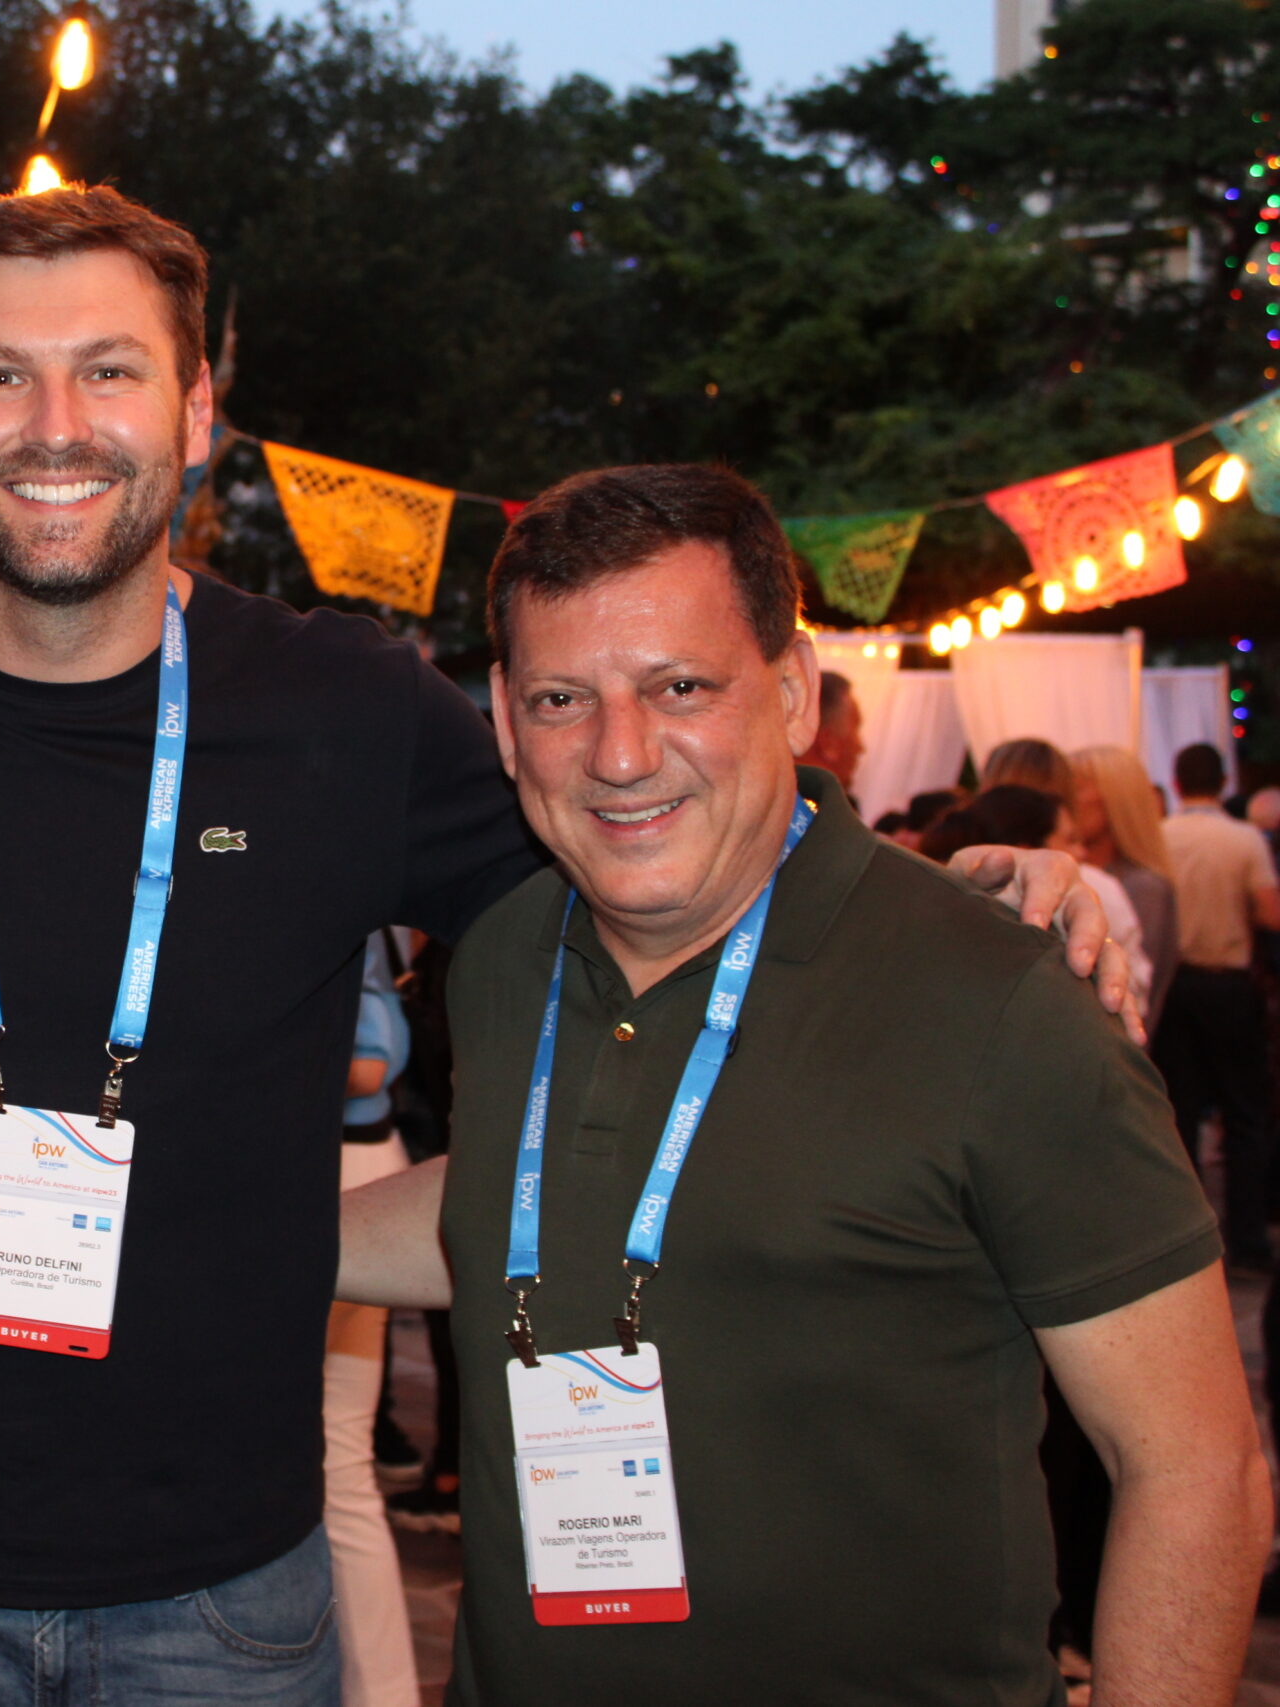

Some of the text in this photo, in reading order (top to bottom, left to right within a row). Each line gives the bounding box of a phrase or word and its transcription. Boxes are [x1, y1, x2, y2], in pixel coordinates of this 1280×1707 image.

[164, 605, 174, 668] AMERICAN
[173, 609, 183, 662] EXPRESS
[158, 702, 183, 738] ipw
[150, 758, 168, 830] AMERICAN
[161, 759, 177, 822] EXPRESS
[722, 932, 752, 971] ipw
[126, 947, 144, 1012] EXPRESS
[135, 940, 155, 1013] AMERICAN
[720, 994, 738, 1032] RESS
[524, 1086, 540, 1150] EXPRESS
[532, 1076, 548, 1149] AMERICAN
[32, 1136, 66, 1159] ipw
[658, 1103, 692, 1170] EXPRESS
[667, 1096, 702, 1173] AMERICAN
[4, 1174, 15, 1182] the
[17, 1174, 43, 1186] World
[43, 1179, 51, 1187] to
[53, 1181, 81, 1192] America
[83, 1185, 91, 1193] at
[519, 1173, 541, 1211] ipw
[640, 1193, 669, 1236] ipw
[35, 1256, 82, 1272] DELFINI
[47, 1272, 60, 1282] de
[63, 1274, 102, 1289] Turismo
[37, 1282, 54, 1291] Brazil
[0, 1327, 49, 1342] BUYER
[568, 1381, 598, 1406] ipw
[525, 1431, 550, 1441] Bringing
[551, 1431, 561, 1439] the
[595, 1425, 622, 1434] America
[530, 1464, 555, 1486] ipw
[539, 1531, 667, 1547] Virazom Viagens Operadora
[559, 1515, 642, 1531] ROGERIO MARI
[578, 1548, 628, 1559] de Turismo
[585, 1602, 631, 1614] BUYER
